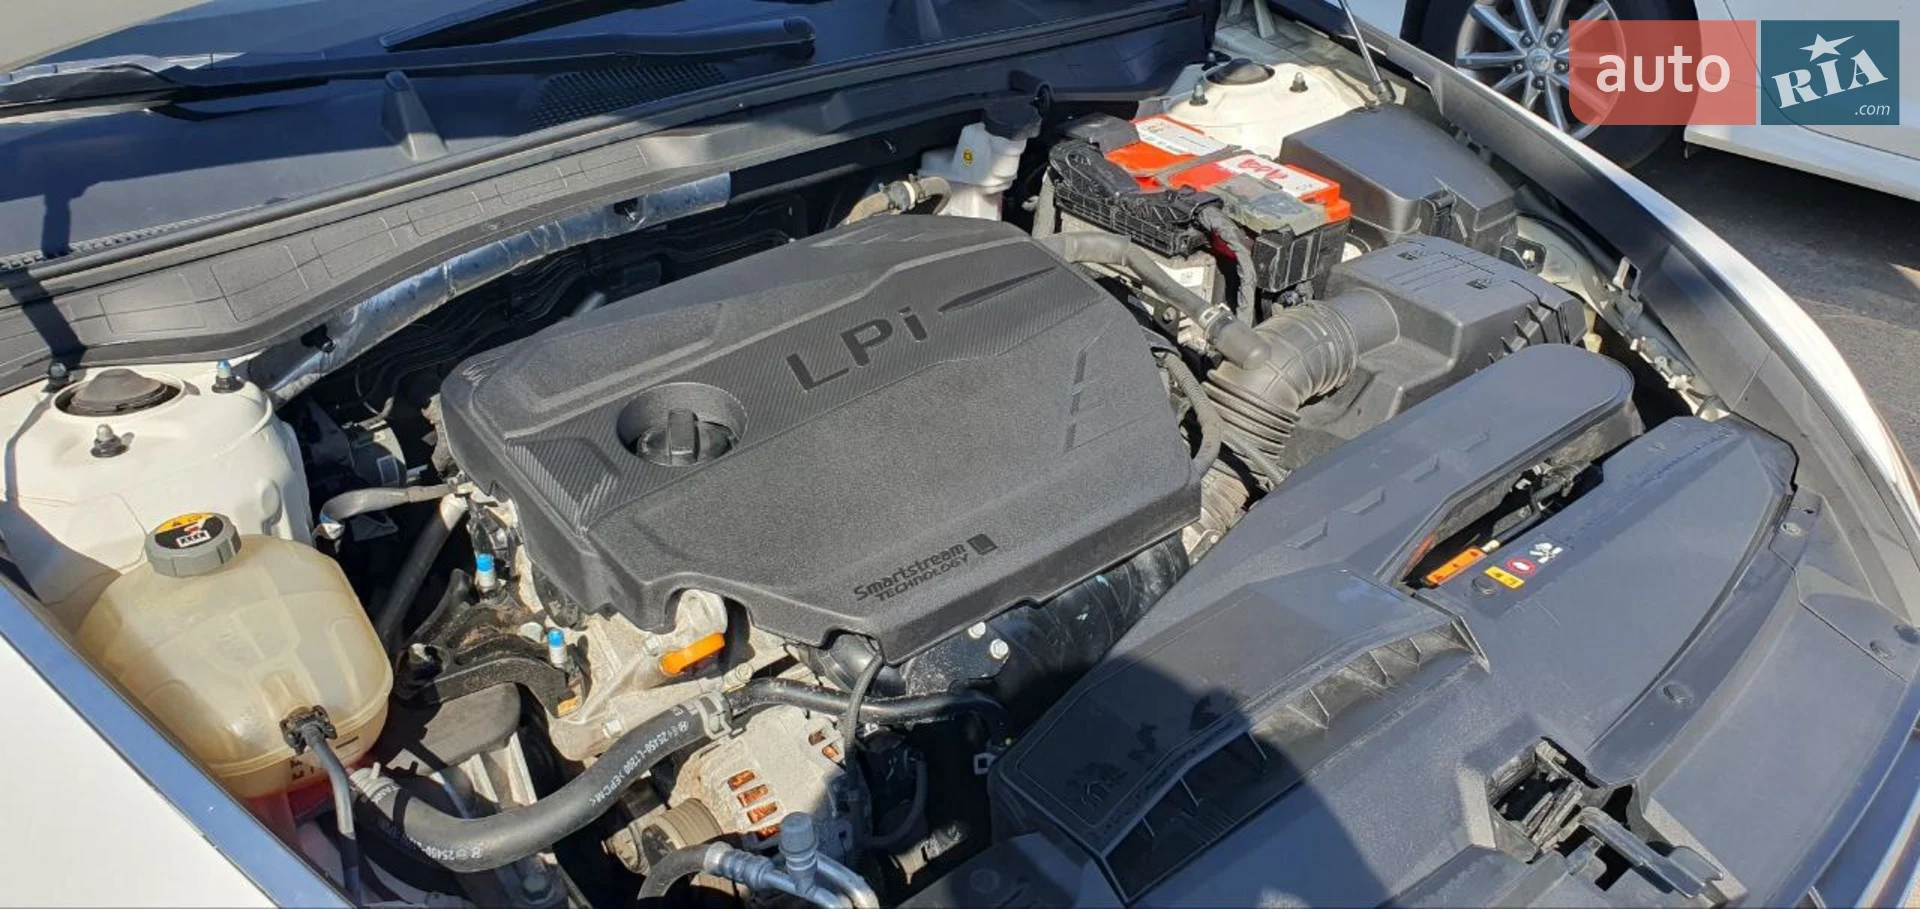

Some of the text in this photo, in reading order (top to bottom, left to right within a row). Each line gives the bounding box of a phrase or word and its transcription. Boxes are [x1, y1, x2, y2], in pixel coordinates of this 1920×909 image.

[786, 306, 928, 391] LPi
[853, 544, 966, 601] Smartstream
[874, 553, 968, 602] TECHNOLOGY
